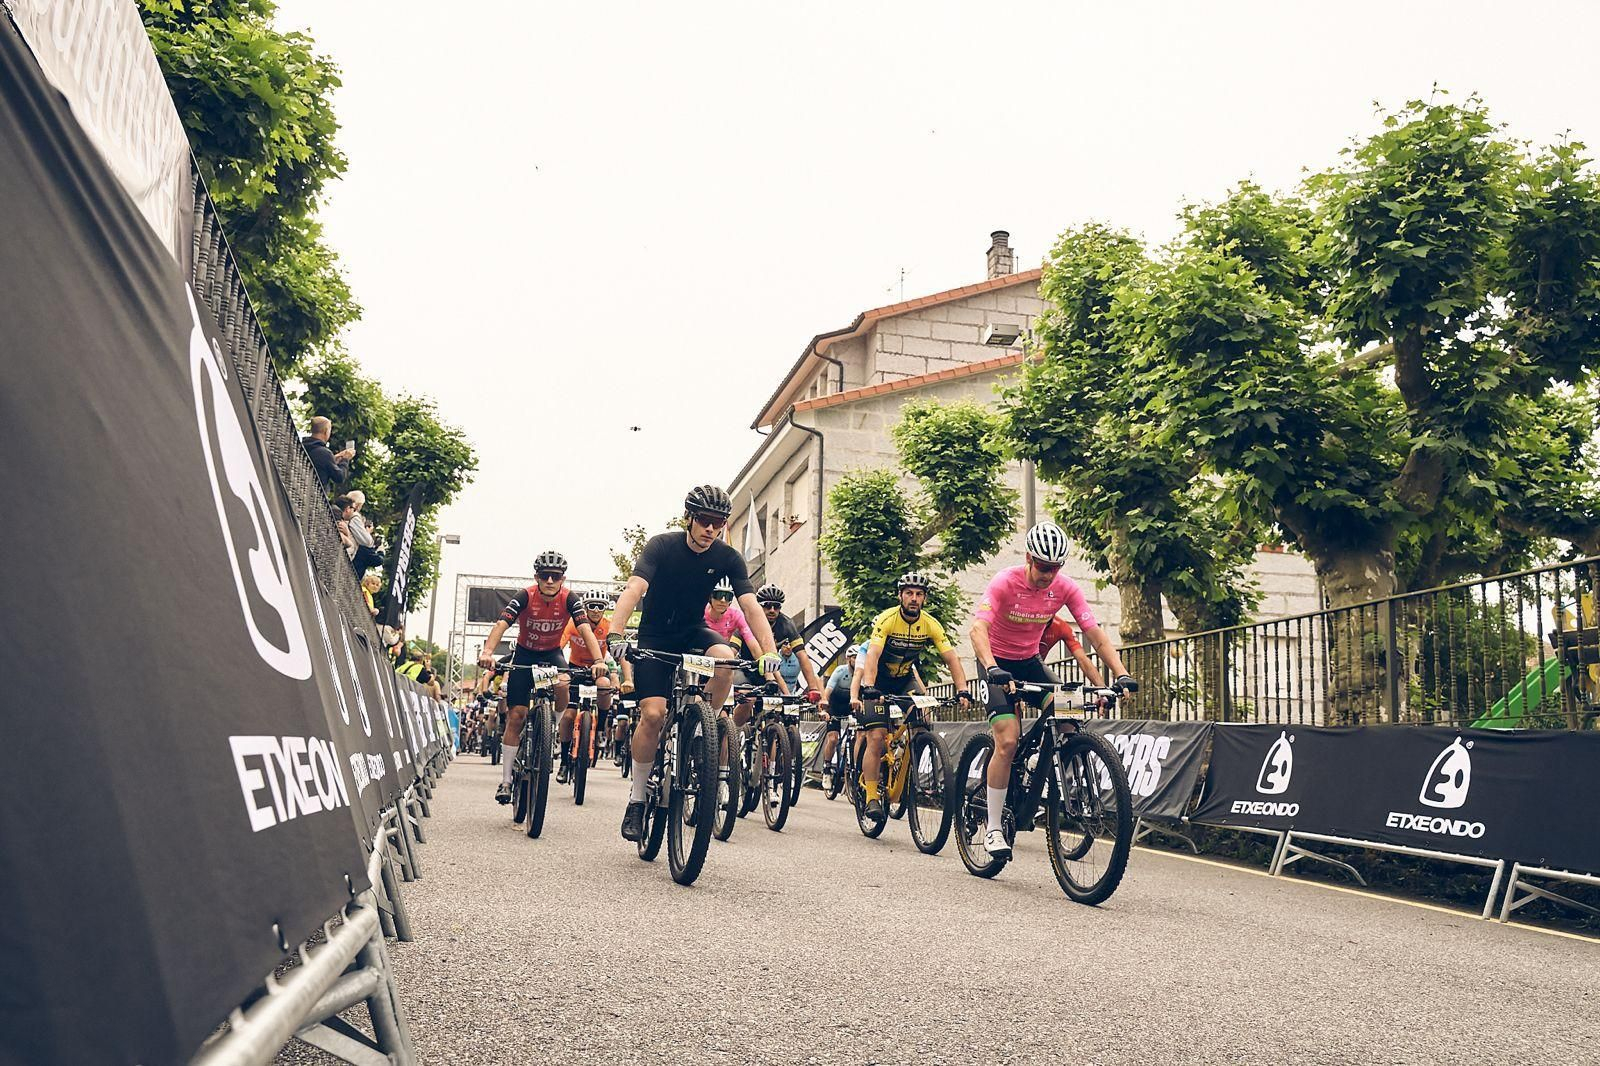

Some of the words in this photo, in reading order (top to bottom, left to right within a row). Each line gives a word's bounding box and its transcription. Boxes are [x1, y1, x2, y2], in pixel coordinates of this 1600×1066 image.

[526, 619, 563, 632] FROIZ
[688, 656, 711, 668] 133
[1066, 700, 1072, 711] 1
[228, 735, 350, 832] ETXEON
[1230, 800, 1299, 816] ETXEONDO
[1386, 812, 1486, 839] ETXEONDO
